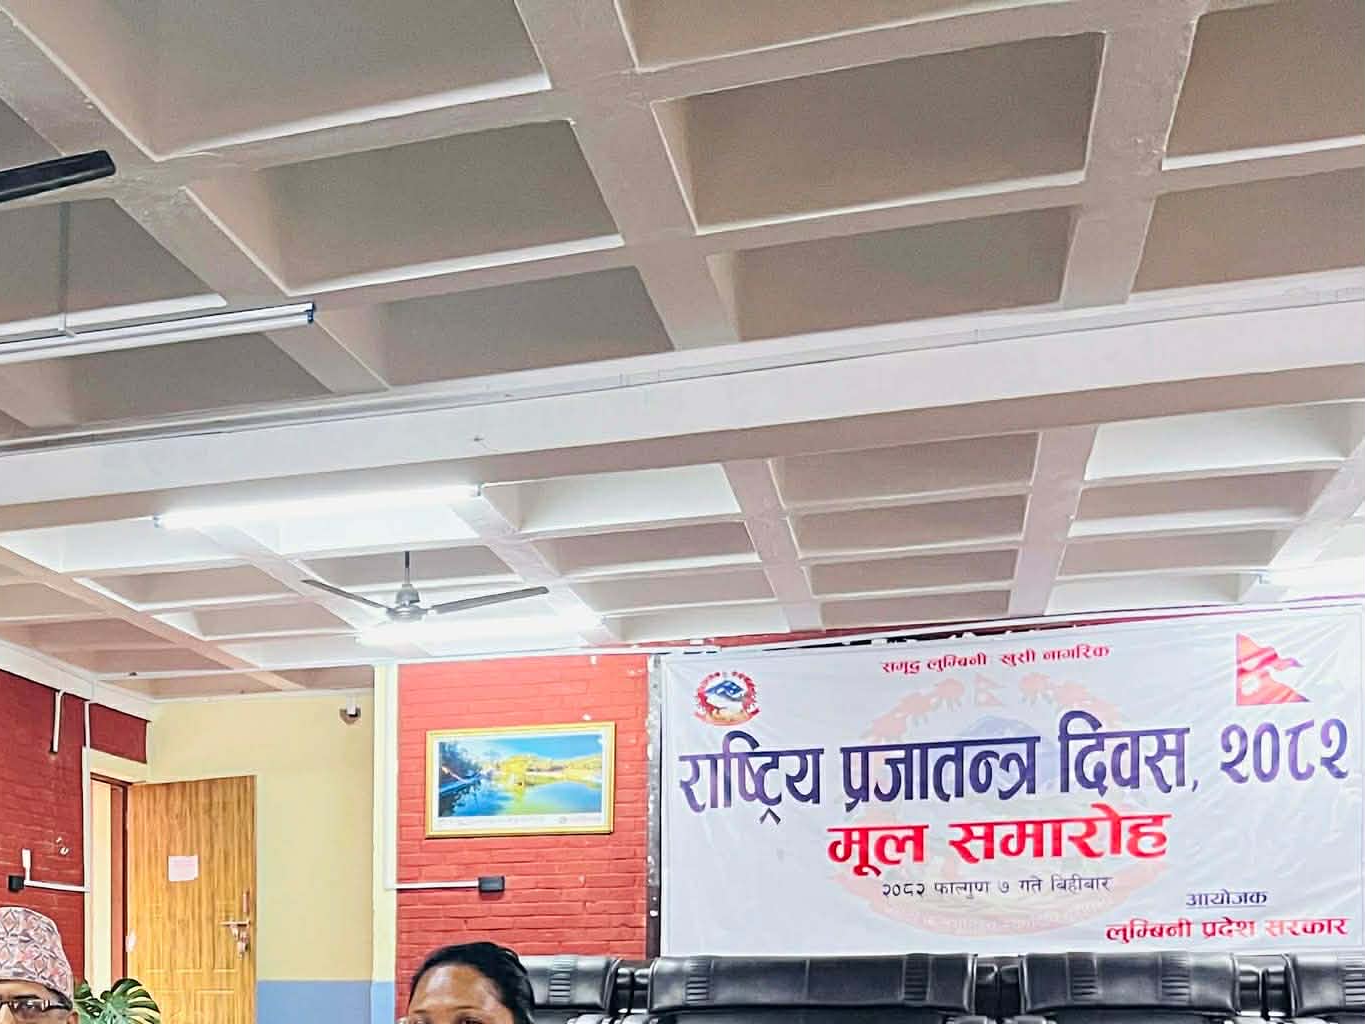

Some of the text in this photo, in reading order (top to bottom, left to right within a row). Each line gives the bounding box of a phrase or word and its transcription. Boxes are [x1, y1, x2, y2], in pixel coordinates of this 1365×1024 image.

[927, 652, 987, 672] लुम्बिनी
[1042, 643, 1113, 662] नागरिक
[679, 710, 1349, 825] राष्ट्रिय प्रजातन्त्र दिवस, २०८२
[827, 803, 1173, 877] मूल समारोह
[882, 882, 926, 898] २०८२
[998, 881, 1010, 894] ७
[1018, 875, 1044, 893] गते
[1186, 888, 1269, 907] आयोजक
[1106, 916, 1355, 944] लुम्बिनी प्रदेश सरकार
